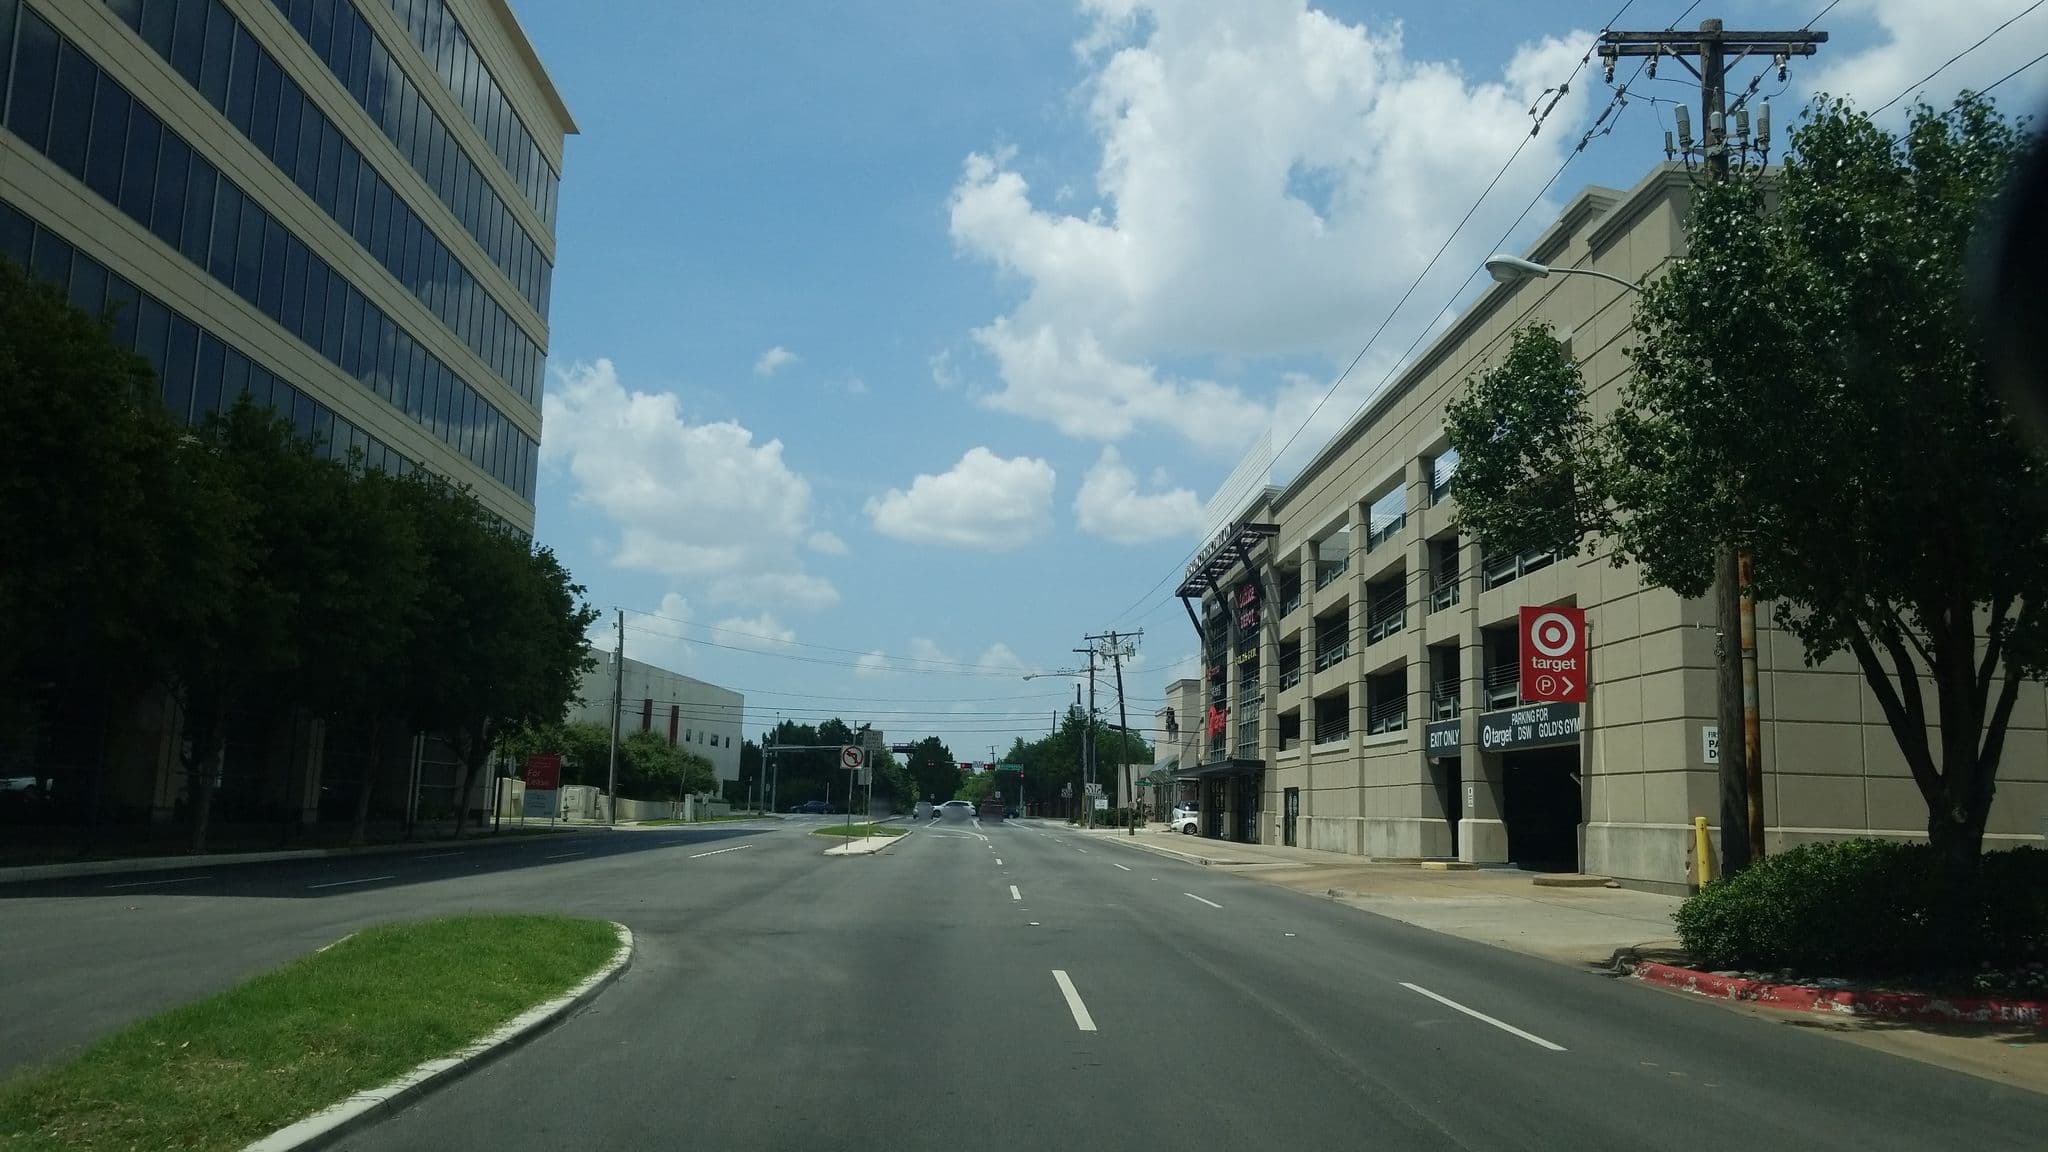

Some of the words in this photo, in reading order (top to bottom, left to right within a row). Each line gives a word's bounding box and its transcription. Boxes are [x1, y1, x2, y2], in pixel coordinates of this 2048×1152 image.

[1532, 656, 1577, 672] target
[1511, 710, 1535, 726] PARKING
[1536, 708, 1549, 722] FOR
[1430, 731, 1443, 748] EXIT
[1443, 729, 1460, 746] ONLY
[1492, 726, 1513, 746] target
[1518, 725, 1532, 740] DSW
[1538, 720, 1563, 738] GOLD'S
[1564, 717, 1581, 734] GYM
